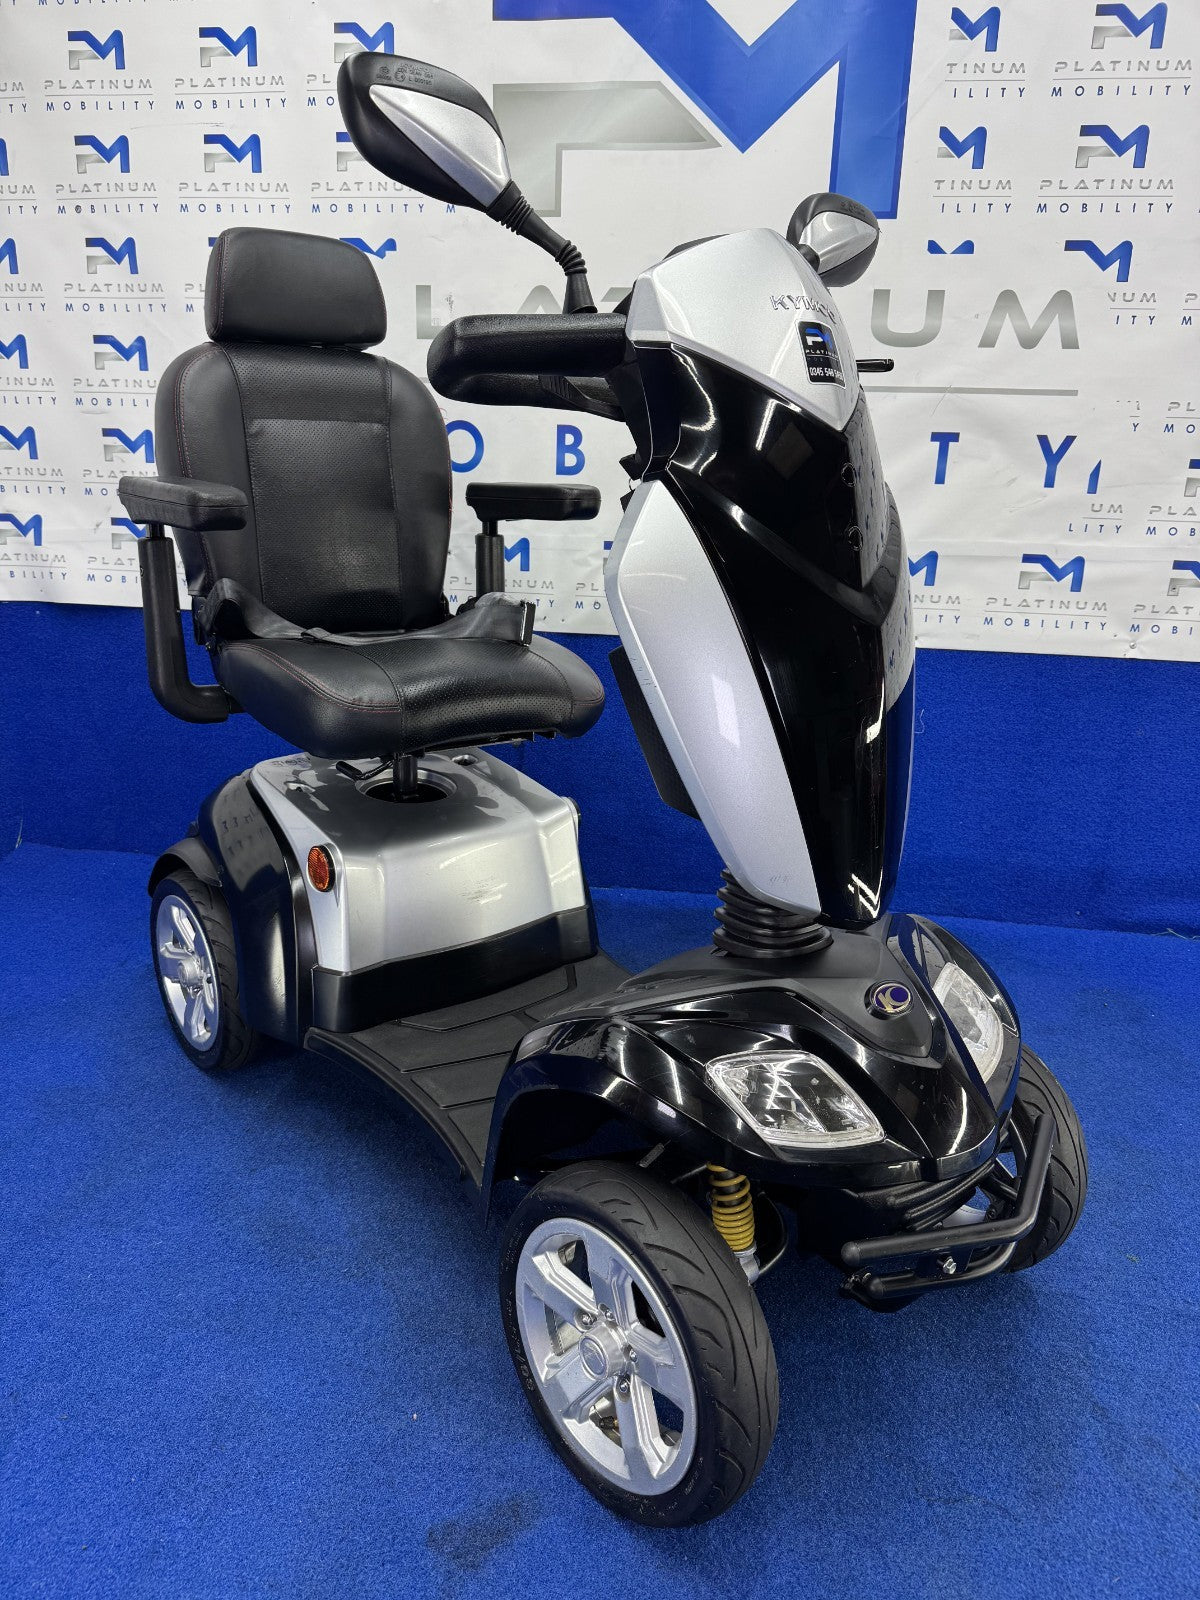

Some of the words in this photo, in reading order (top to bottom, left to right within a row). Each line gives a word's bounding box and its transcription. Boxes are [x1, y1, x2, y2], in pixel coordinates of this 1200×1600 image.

[1054, 59, 1192, 73] PLATINUM
[43, 78, 153, 90] PLATINUM
[174, 75, 285, 88] PLATINUM
[1050, 84, 1191, 97] MOBILITY
[46, 100, 155, 112] MOBILITY
[175, 97, 287, 110] MOBILITY
[55, 182, 157, 194] PLATINUM
[178, 182, 289, 193] PLATINUM
[1039, 178, 1174, 190] PLATINUM
[57, 203, 159, 215] MOBILITY
[179, 203, 291, 214] MOBILITY
[311, 203, 425, 214] MOBILITY
[1036, 202, 1173, 214] MOBILITY
[64, 283, 164, 293] PLATINUM
[65, 302, 167, 313] MOBILITY
[984, 596, 1107, 611] PLATINUM
[983, 616, 1107, 631] MOBILITY
